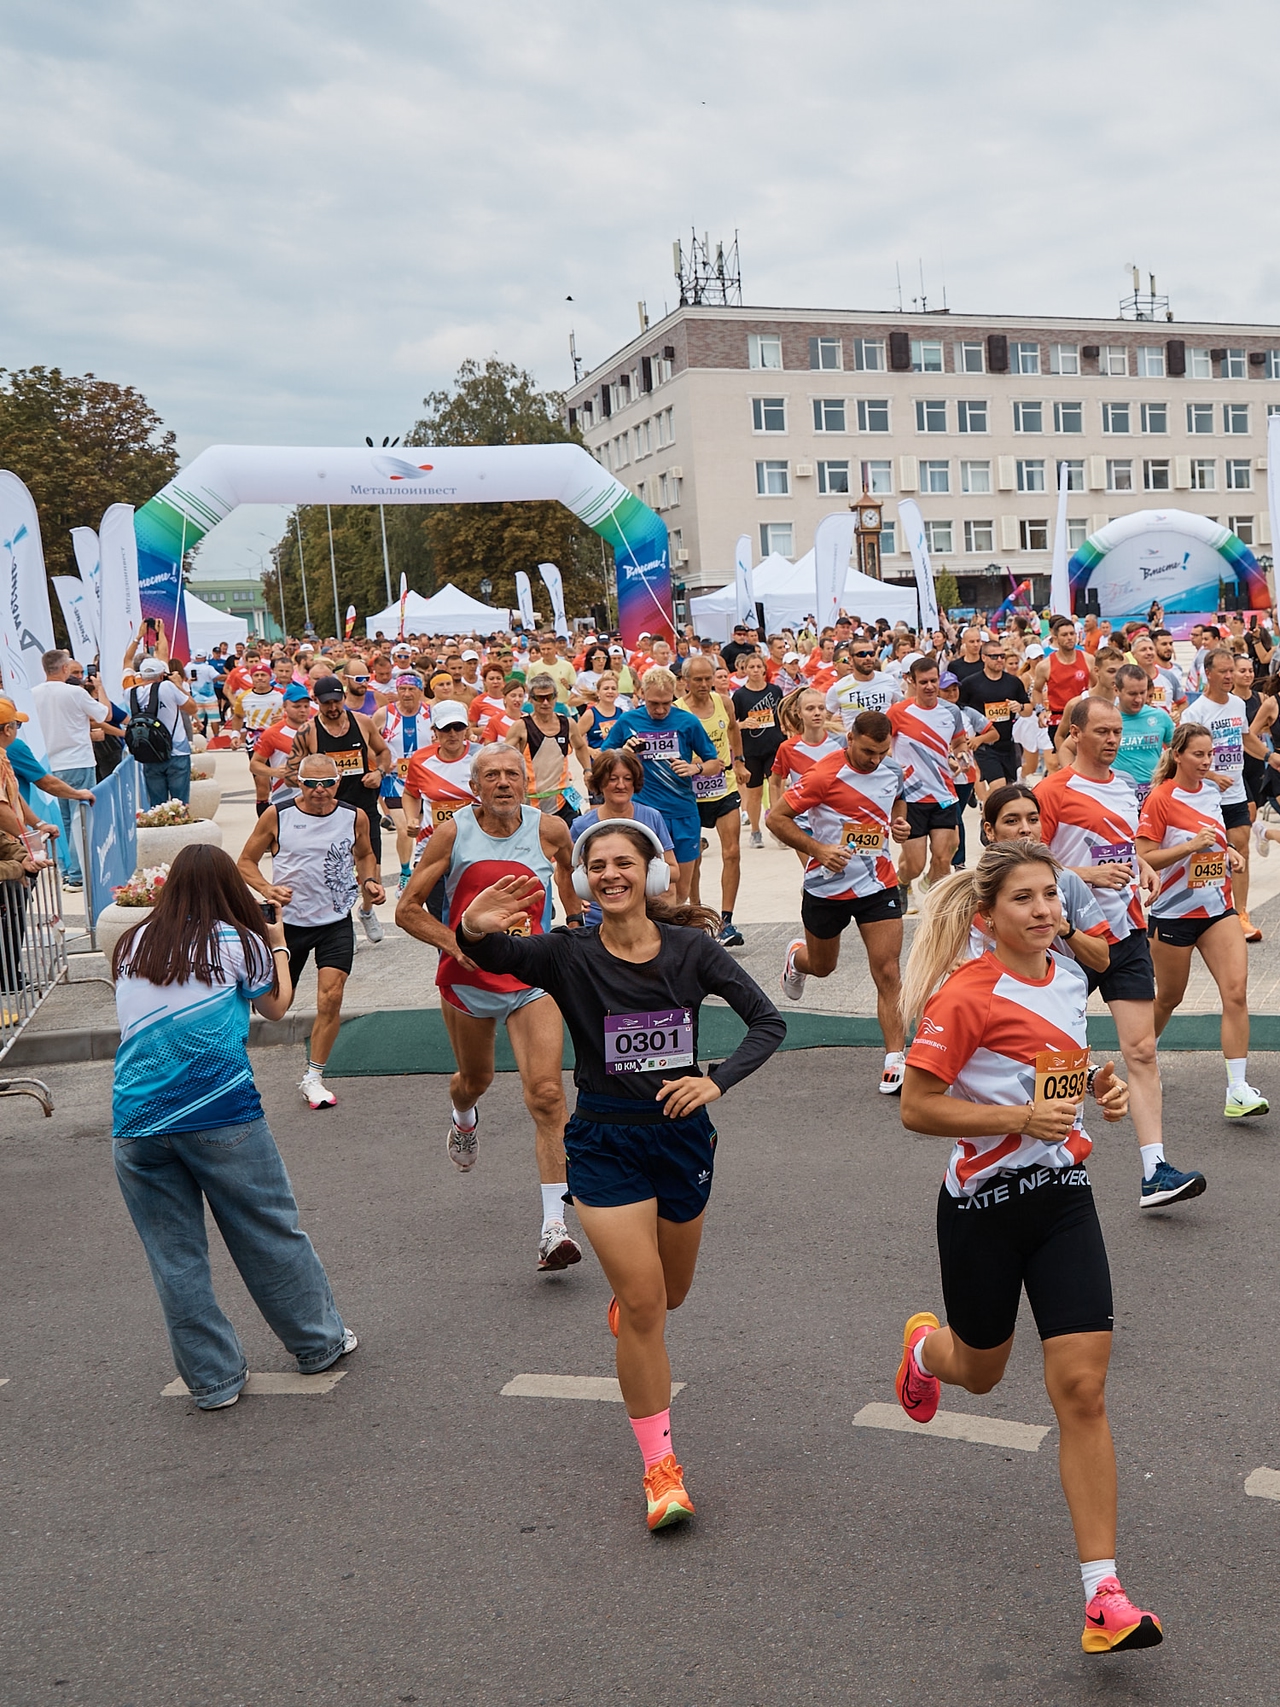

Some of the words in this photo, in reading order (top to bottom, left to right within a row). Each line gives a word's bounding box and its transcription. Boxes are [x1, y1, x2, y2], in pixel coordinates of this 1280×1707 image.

[350, 485, 457, 495] Металлоинвест
[988, 707, 1008, 716] 0402
[644, 739, 674, 751] 0184
[1219, 753, 1242, 763] 0310
[696, 778, 724, 790] 0232
[846, 833, 879, 846] 0430
[1194, 863, 1223, 877] 0435
[615, 1028, 679, 1054] 0301
[614, 1062, 623, 1071] 10
[624, 1062, 636, 1070] KM
[1043, 1071, 1085, 1100] 0393
